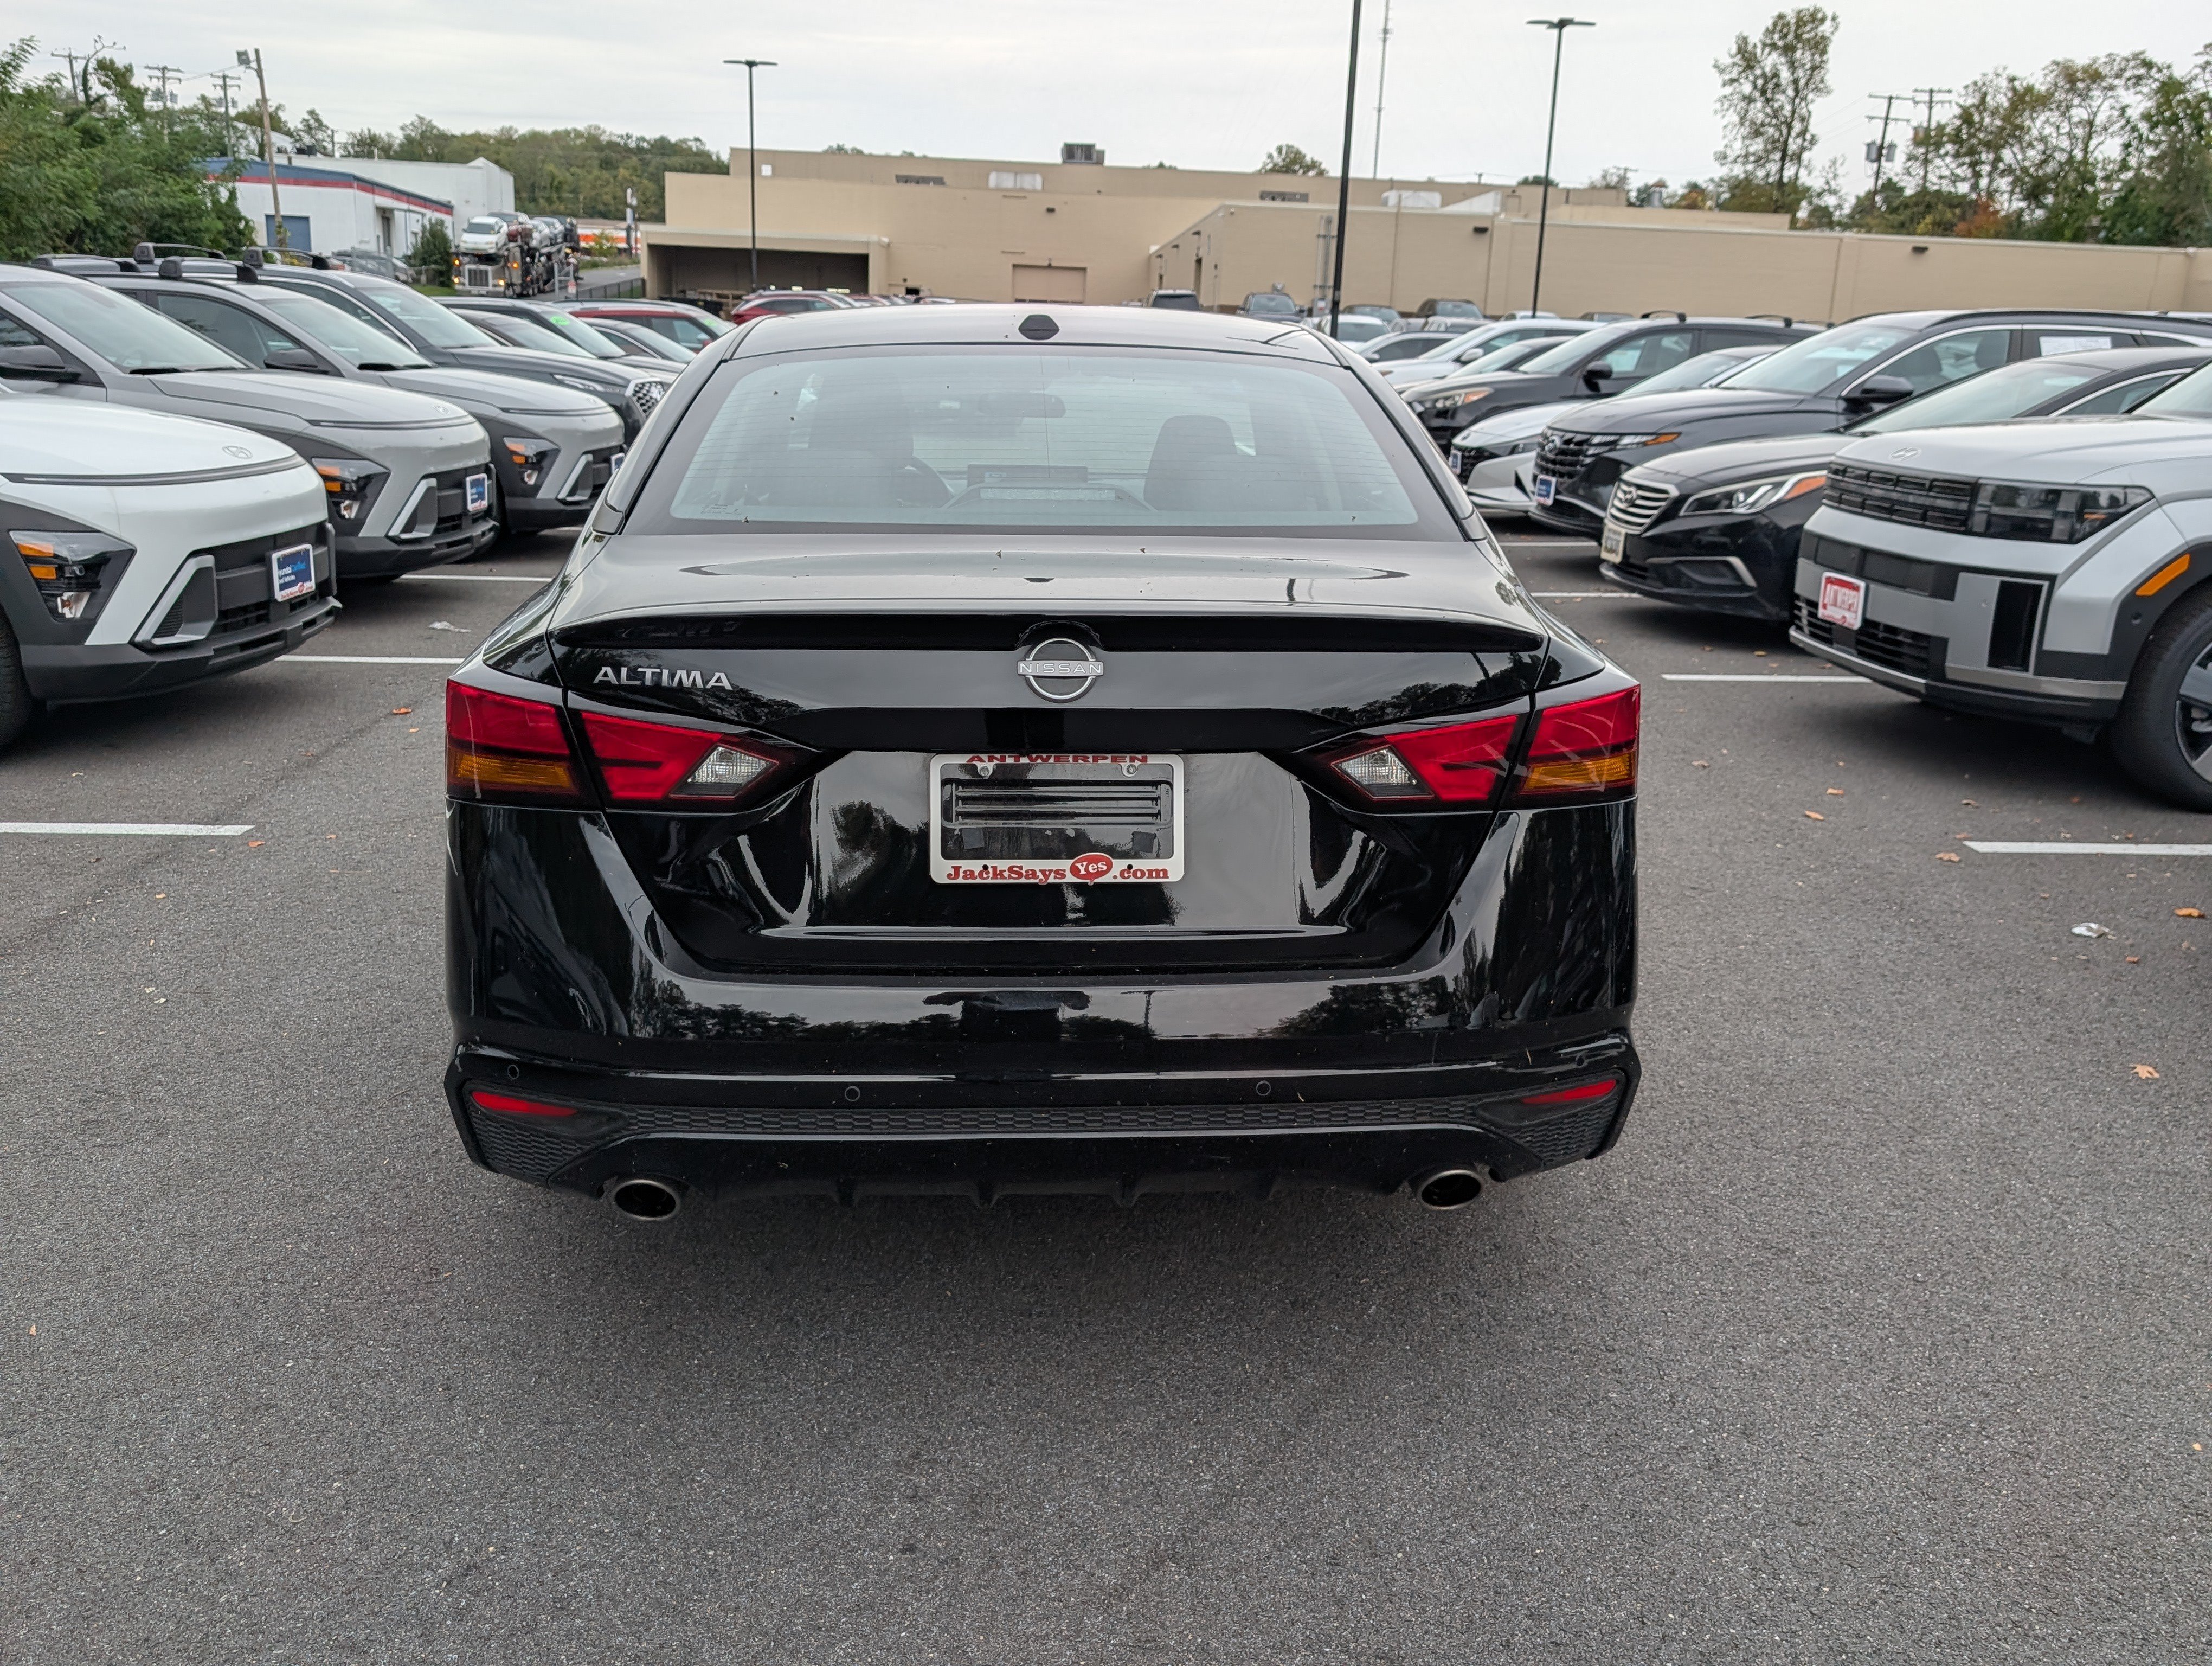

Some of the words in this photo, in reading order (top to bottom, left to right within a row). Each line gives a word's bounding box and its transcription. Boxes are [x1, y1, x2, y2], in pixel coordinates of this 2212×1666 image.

[1019, 663, 1101, 674] NISSAN
[593, 667, 733, 690] ALTIMA
[966, 754, 1148, 764] ANTWERPEN
[1075, 860, 1108, 875] Yes
